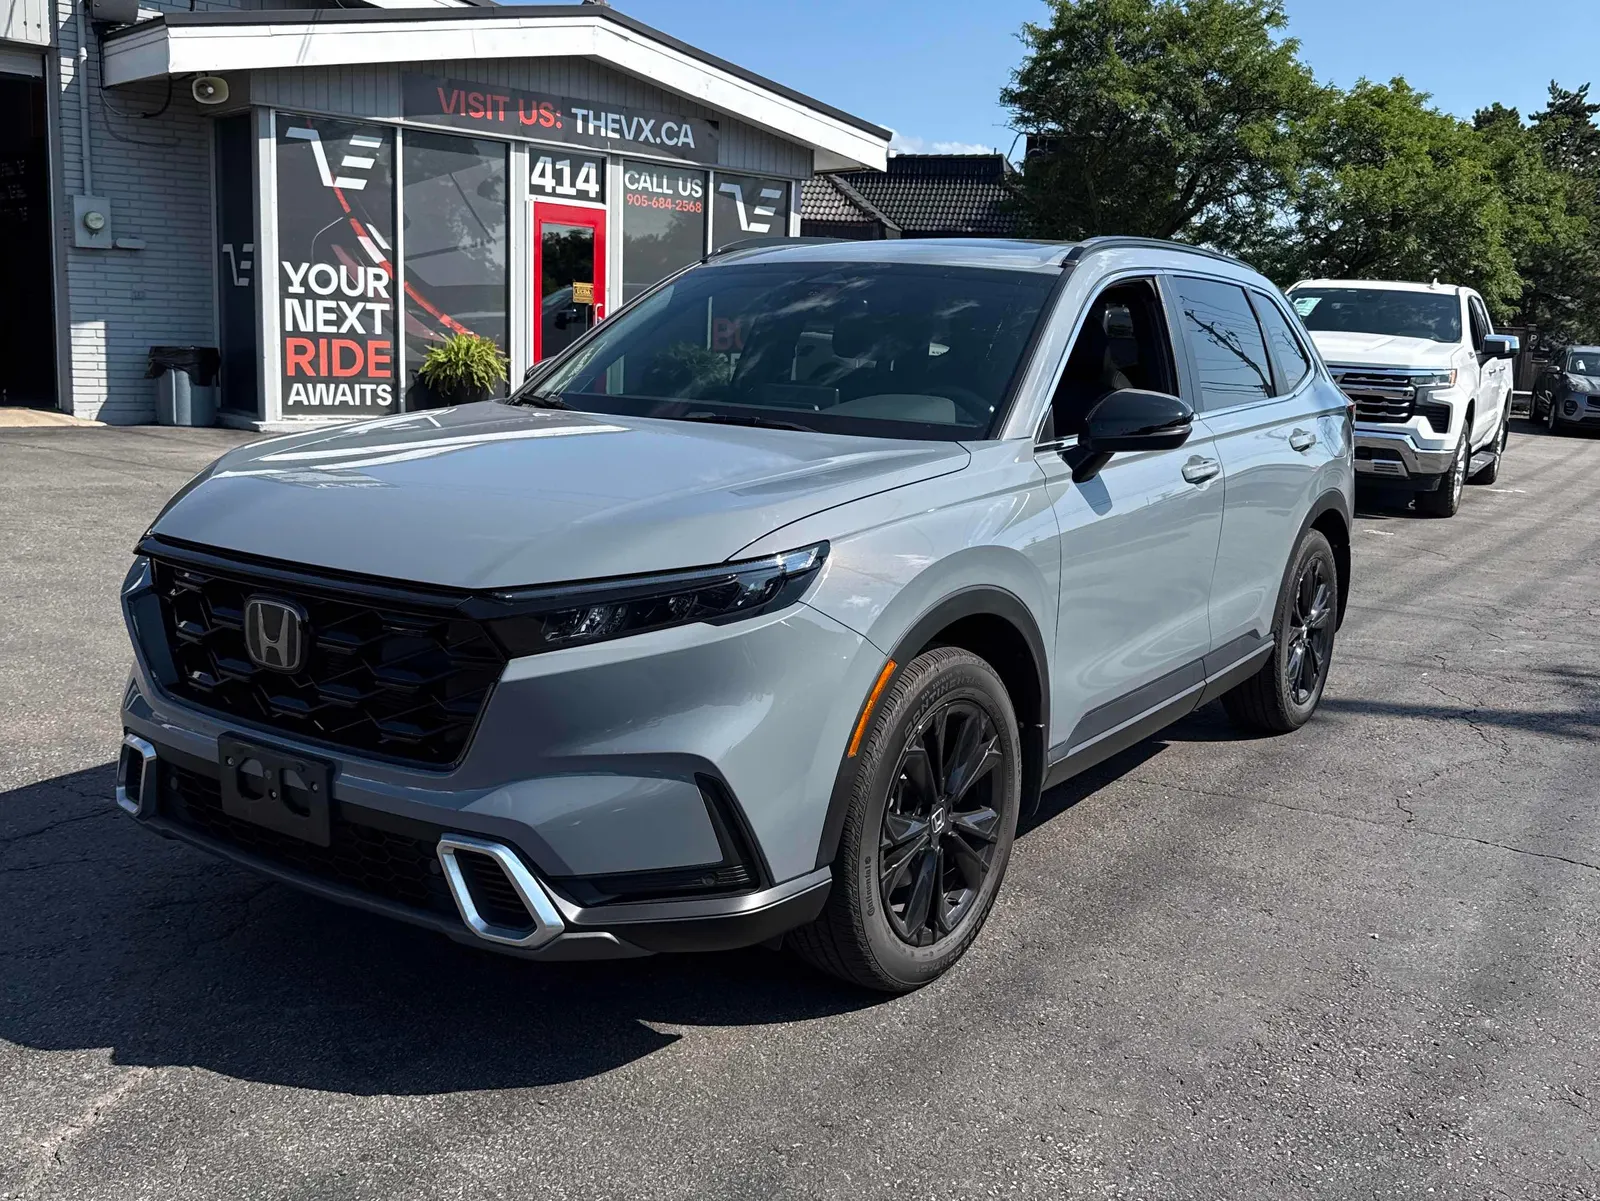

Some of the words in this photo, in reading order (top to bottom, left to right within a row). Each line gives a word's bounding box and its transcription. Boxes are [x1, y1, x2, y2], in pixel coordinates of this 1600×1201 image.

[437, 87, 510, 122] VISIT
[519, 99, 562, 129] US:
[571, 107, 695, 149] THEVX.CA
[530, 156, 599, 198] 414
[624, 170, 673, 195] CALL
[678, 177, 702, 198] US
[626, 193, 702, 213] 905-684-2568
[282, 260, 390, 299] YOUR
[284, 298, 390, 335] NEXT
[286, 337, 391, 378] RIDE
[287, 382, 393, 406] AWAITS
